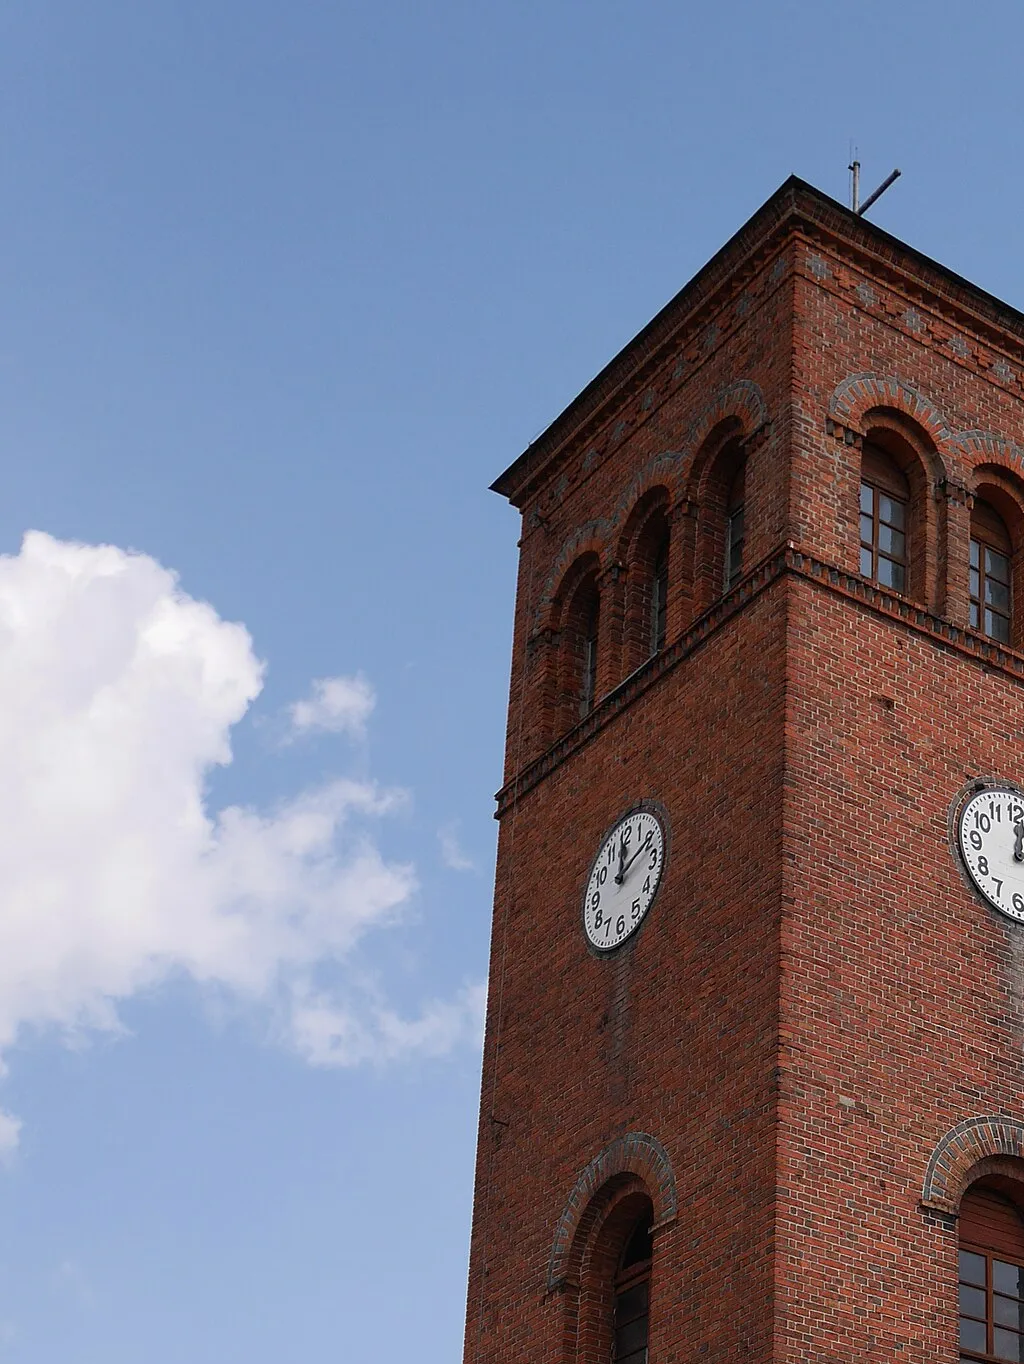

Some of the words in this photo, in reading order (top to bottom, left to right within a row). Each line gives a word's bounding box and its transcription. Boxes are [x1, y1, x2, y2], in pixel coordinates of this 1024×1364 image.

[974, 810, 991, 833] 10
[989, 801, 1001, 823] 11
[1007, 802, 1024, 824] 12
[638, 822, 642, 842] 1
[969, 830, 982, 851] 9
[608, 843, 616, 865] 11
[648, 848, 658, 871] 3
[977, 855, 989, 876] 8
[596, 866, 607, 888] 10
[642, 875, 651, 895] 4
[991, 877, 1003, 898] 7
[591, 891, 600, 912] 9
[631, 897, 641, 920] 5
[1012, 892, 1024, 913] 6
[594, 909, 603, 930] 8
[603, 916, 612, 937] 7
[616, 915, 625, 936] 6
